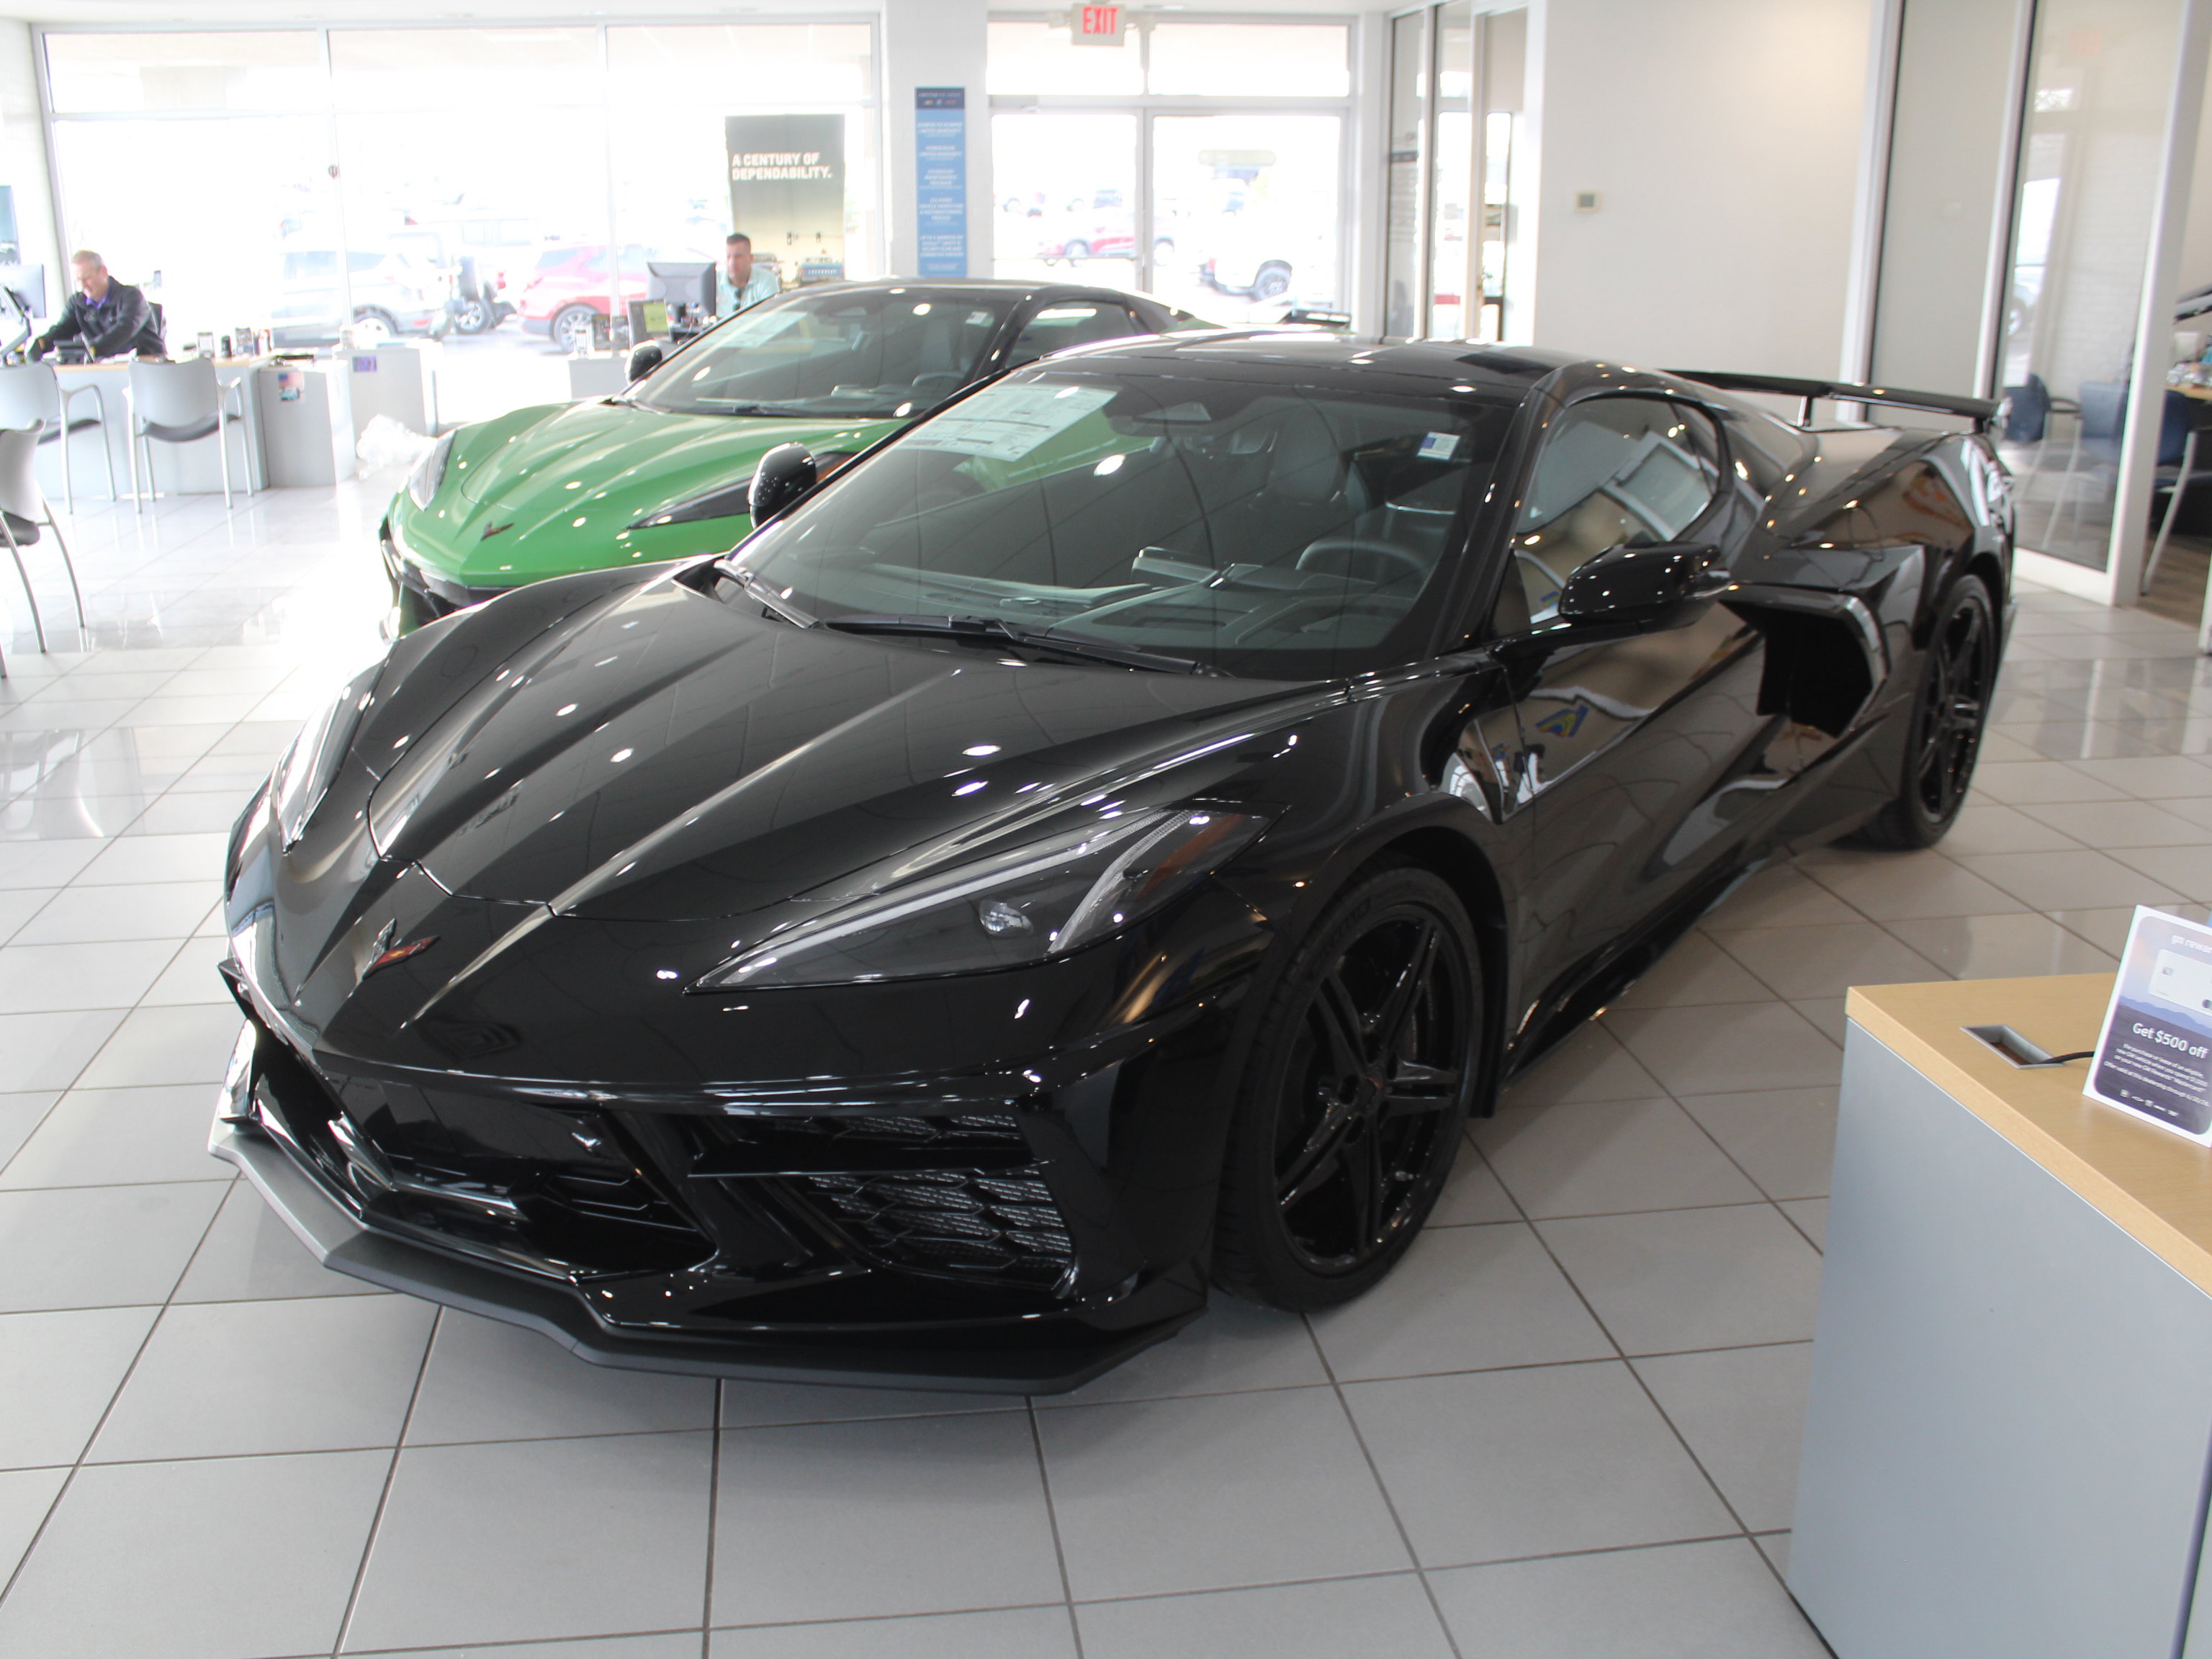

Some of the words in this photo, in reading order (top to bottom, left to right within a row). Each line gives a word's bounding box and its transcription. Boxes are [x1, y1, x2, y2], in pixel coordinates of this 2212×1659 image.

[1083, 6, 1119, 35] EXIT
[732, 153, 741, 166] A
[743, 152, 801, 166] CENTURY
[803, 151, 820, 165] OF
[732, 166, 833, 181] DEPENDABILITY.
[2171, 935, 2185, 945] gm
[2132, 1022, 2155, 1039] Get
[2154, 1030, 2188, 1051] $500
[2188, 1046, 2209, 1059] off
